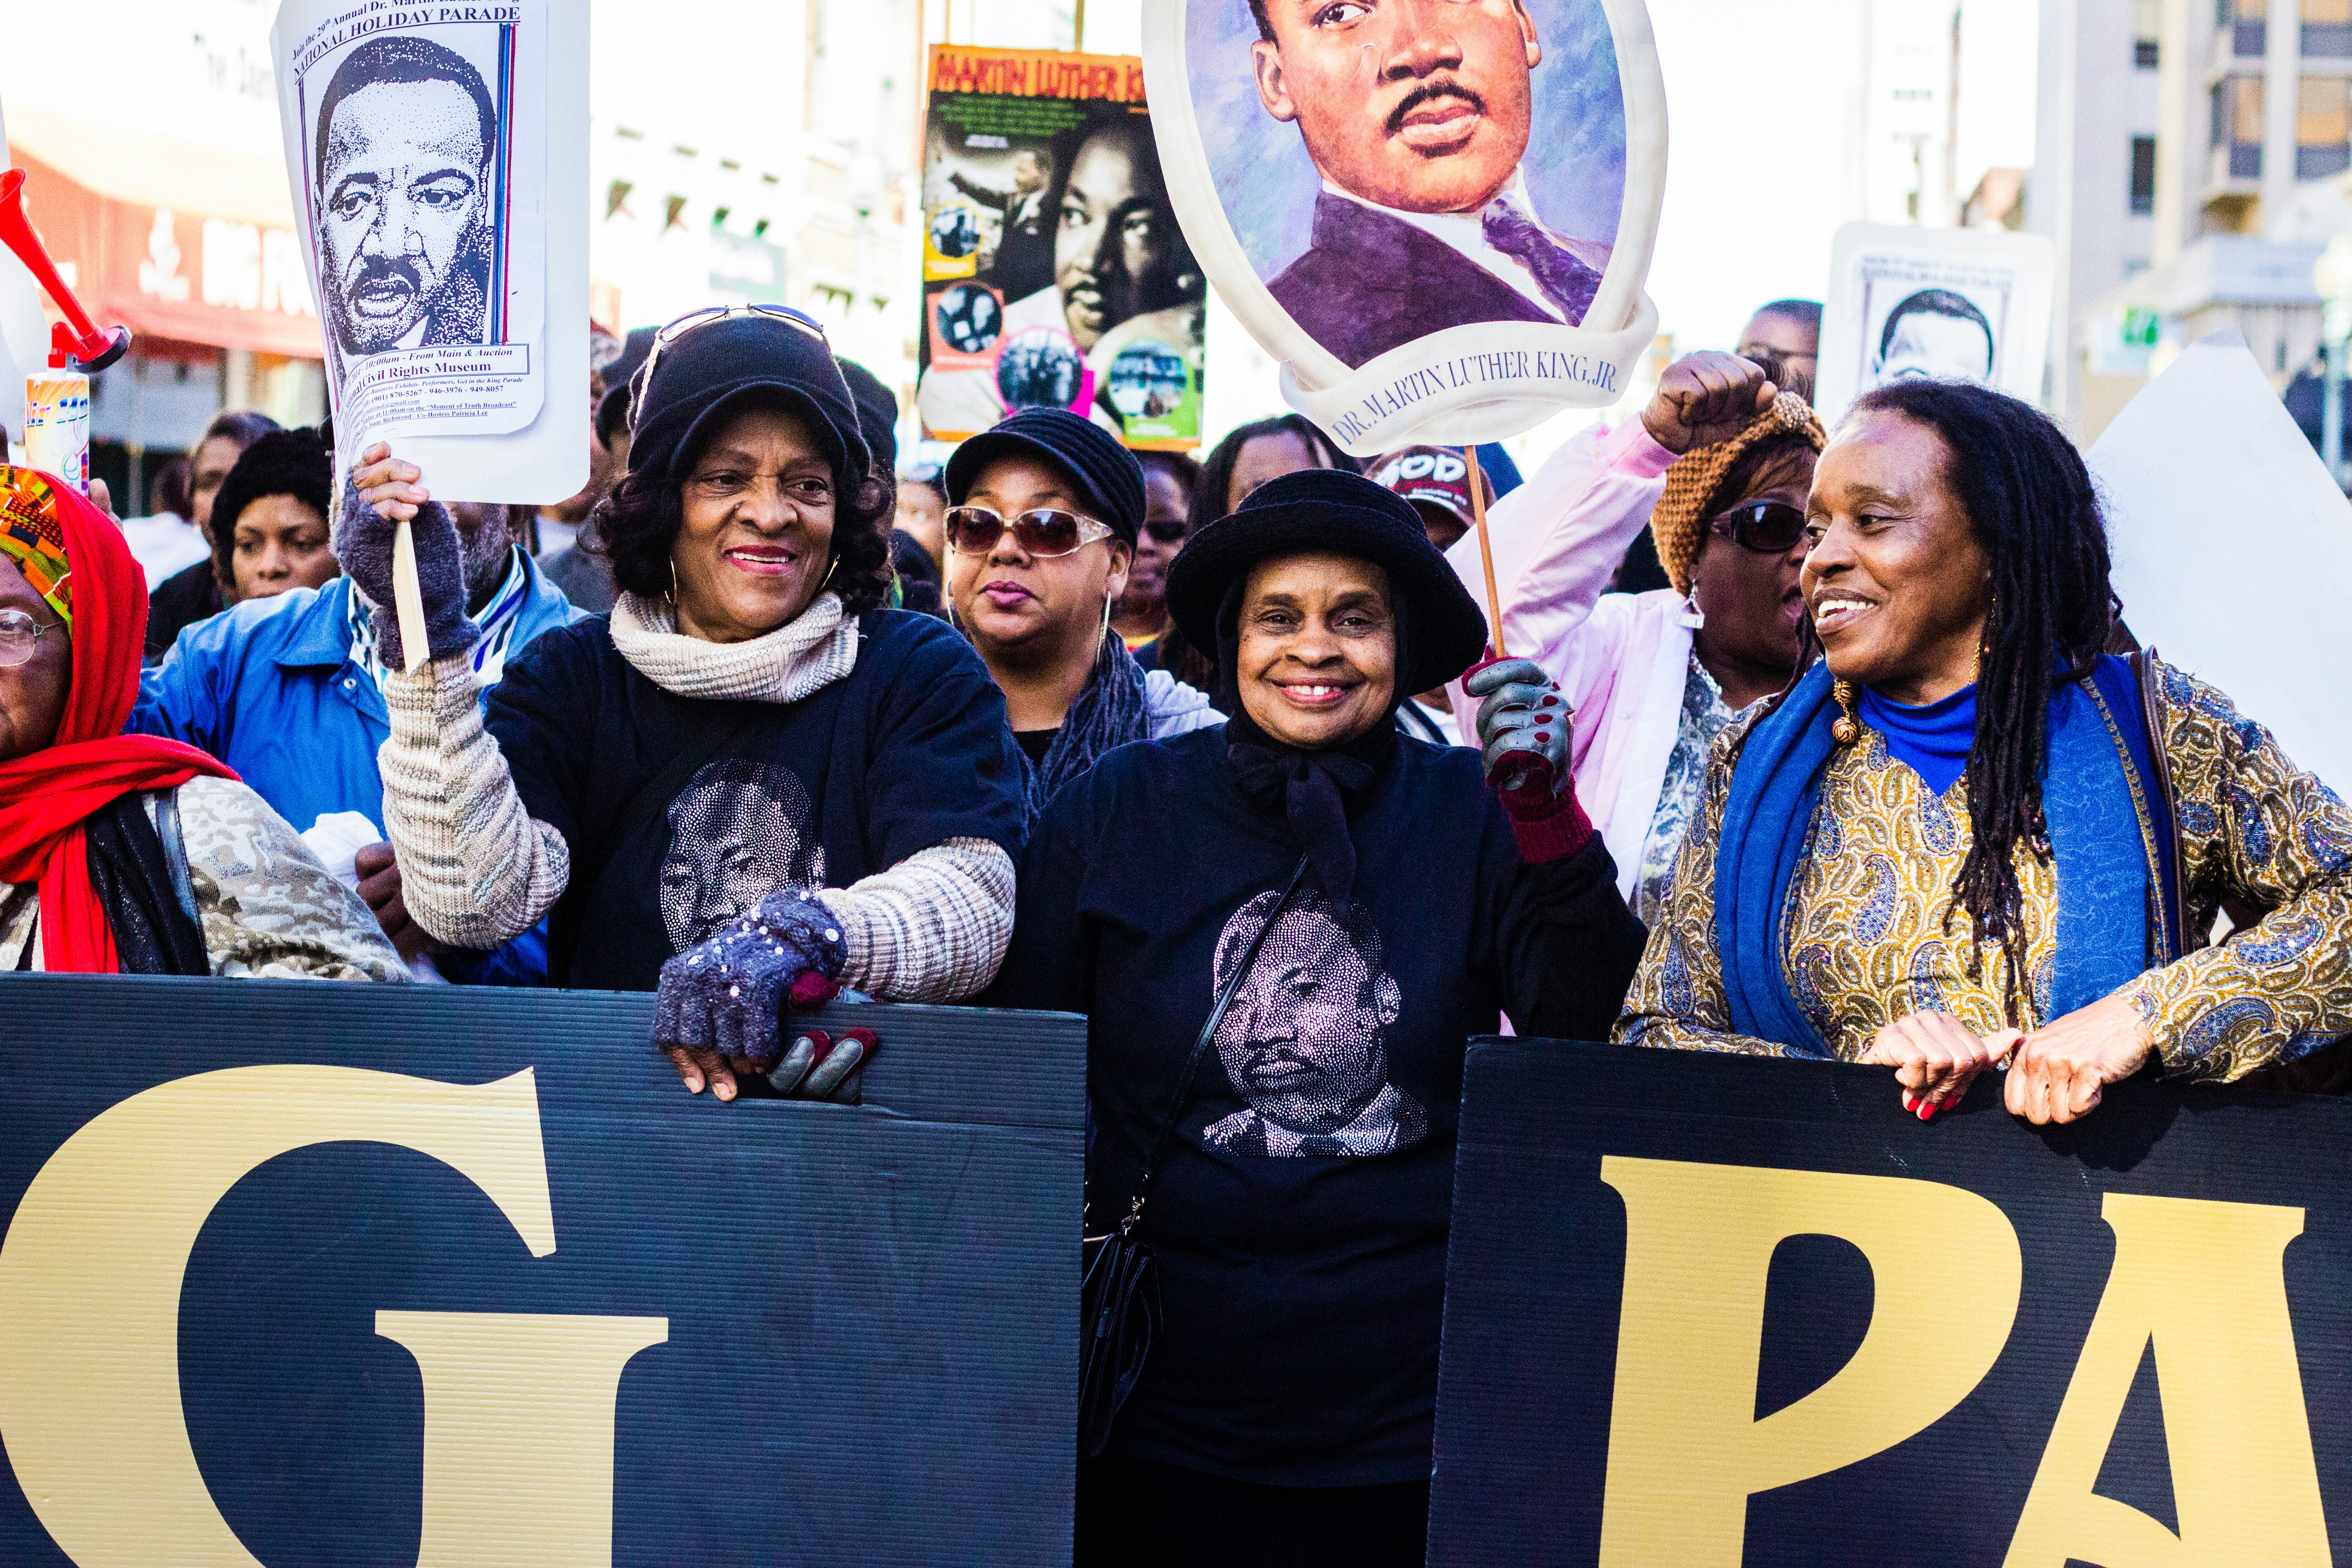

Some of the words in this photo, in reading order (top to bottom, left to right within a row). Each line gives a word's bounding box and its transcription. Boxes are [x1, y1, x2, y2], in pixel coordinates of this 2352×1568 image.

[293, 44, 304, 60] Join
[306, 34, 315, 46] the
[318, 18, 330, 37] 29th
[332, 4, 367, 27] Annual
[370, 1, 387, 11] Dr.
[294, 29, 347, 81] NATIONAL
[351, 9, 433, 37] HOLIDAY
[439, 7, 520, 21] PARADE
[936, 52, 1027, 96] MARTIN
[363, 369, 385, 387] Civil
[389, 366, 430, 379] Rights
[435, 363, 491, 373] Museum
[365, 357, 399, 370] 10:00am
[475, 348, 513, 357] Auction
[372, 394, 388, 404] (901)
[390, 389, 422, 398] 870-5267
[383, 414, 412, 423] Richmond
[1332, 411, 1372, 446] DR.
[1362, 365, 1446, 424] MARTIN
[1447, 351, 1530, 387] LUTHER
[1592, 361, 1617, 392] JR.
[0, 1064, 668, 1568] G
[1598, 1155, 2333, 1568] PA
